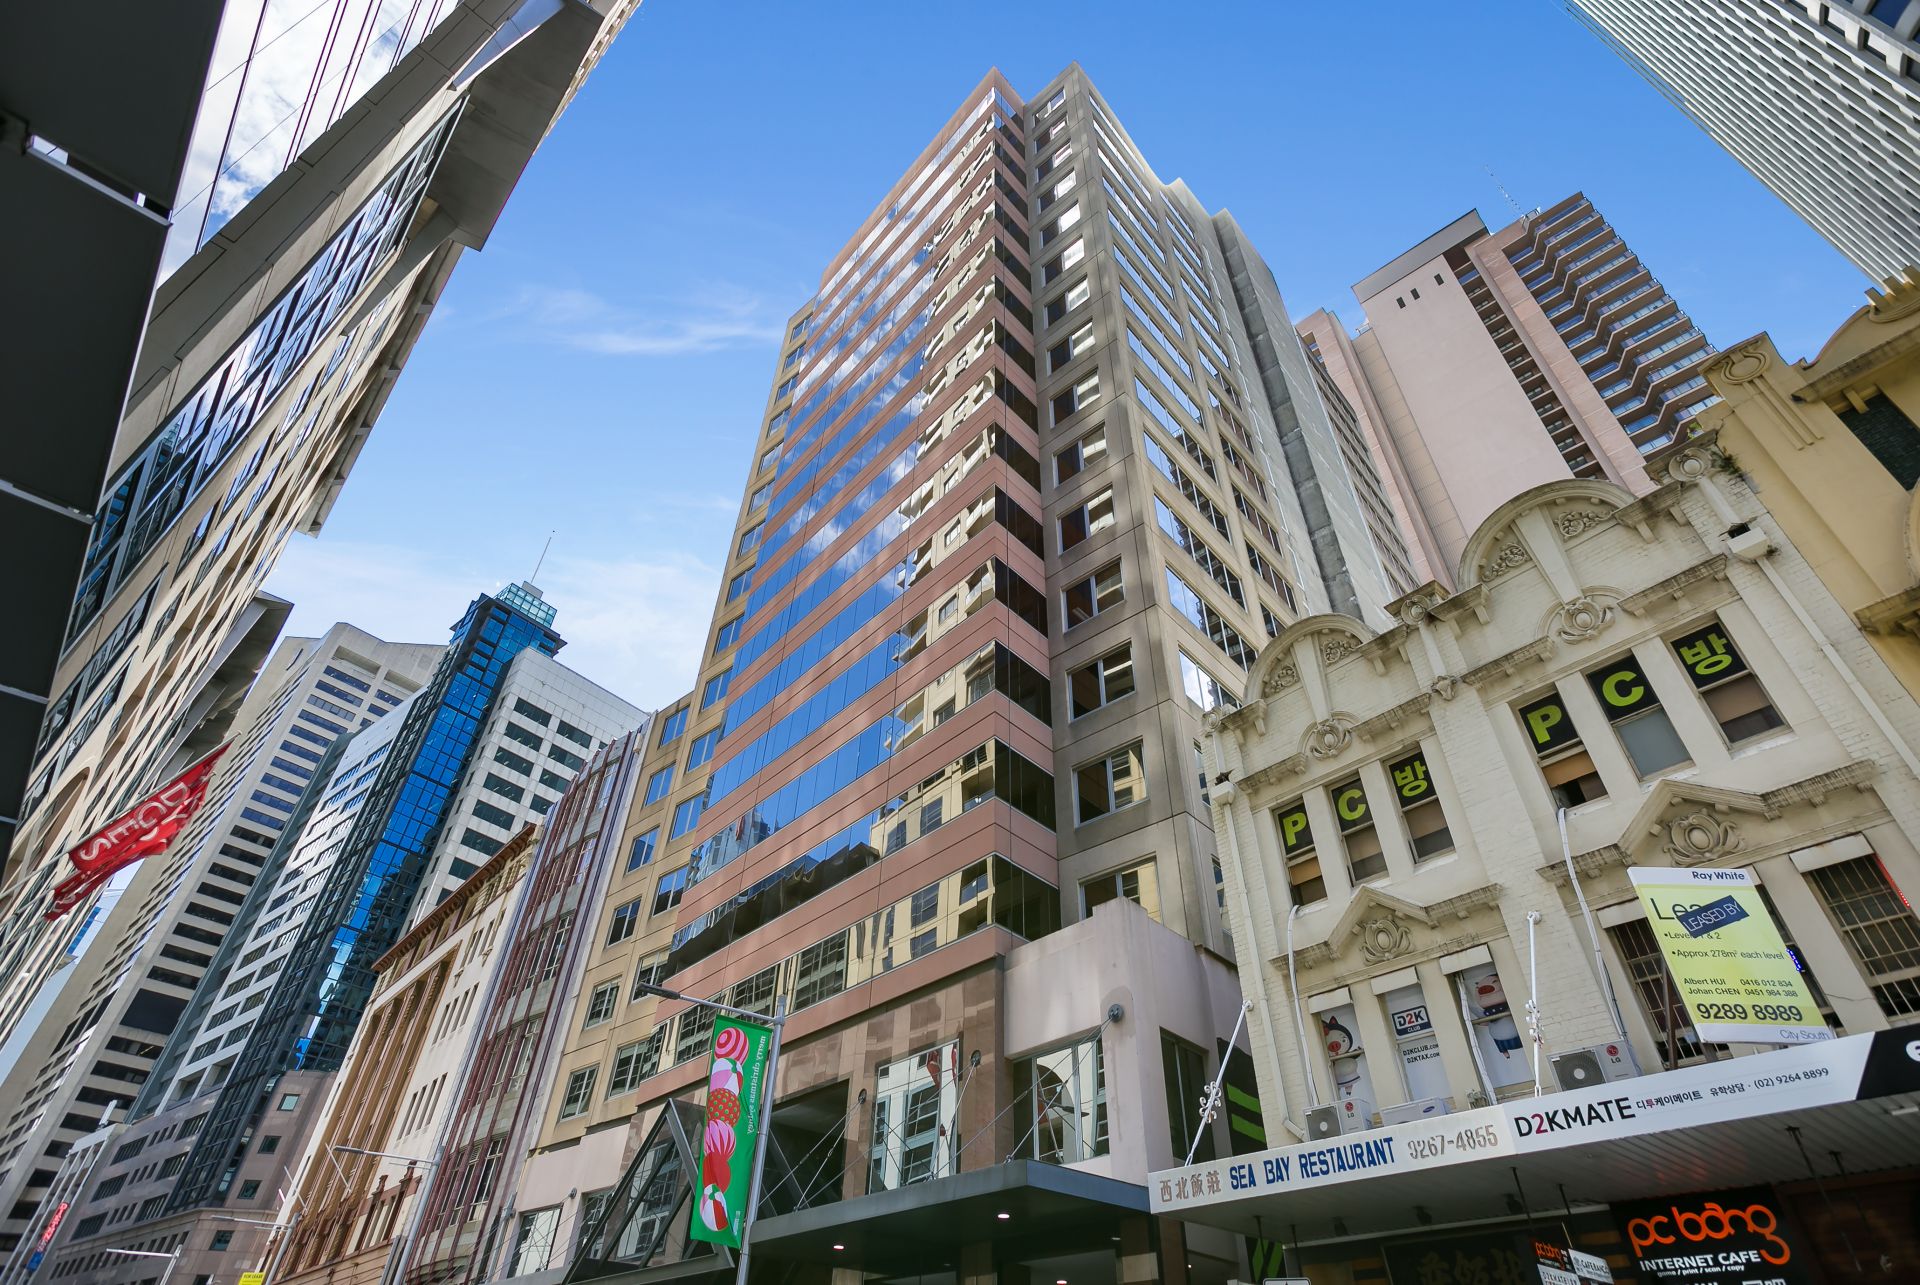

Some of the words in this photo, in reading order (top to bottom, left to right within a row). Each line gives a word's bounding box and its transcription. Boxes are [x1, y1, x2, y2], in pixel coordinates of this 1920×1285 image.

[1691, 871, 1712, 881] Ray
[1713, 871, 1745, 880] White
[1682, 907, 1726, 932] LEASED
[1723, 901, 1741, 916] BY
[1677, 949, 1709, 958] Approx
[1740, 951, 1762, 959] each
[1762, 951, 1785, 960] level
[1688, 987, 1714, 995] Johan
[1714, 987, 1740, 995] CHEN
[1744, 988, 1764, 996] 0451
[1397, 1010, 1425, 1027] D2K
[1696, 1003, 1748, 1020] 9289
[1752, 1004, 1803, 1021] 8989
[1780, 1029, 1799, 1041] City
[1799, 1030, 1830, 1040] South
[1513, 1096, 1636, 1138] D2KMATE
[1753, 1077, 1775, 1090] (02)
[1775, 1072, 1802, 1085] 9264
[1802, 1067, 1829, 1080] 8899
[1229, 1164, 1256, 1190] SEA
[1263, 1156, 1291, 1185] BAY
[1300, 1136, 1396, 1179] RESTAURANT
[1407, 1124, 1498, 1160] 9267-4855
[1627, 1215, 1676, 1258] pc
[1639, 1254, 1714, 1271] INTERNET
[1718, 1250, 1761, 1265] CAFE
[1682, 1267, 1699, 1276] print
